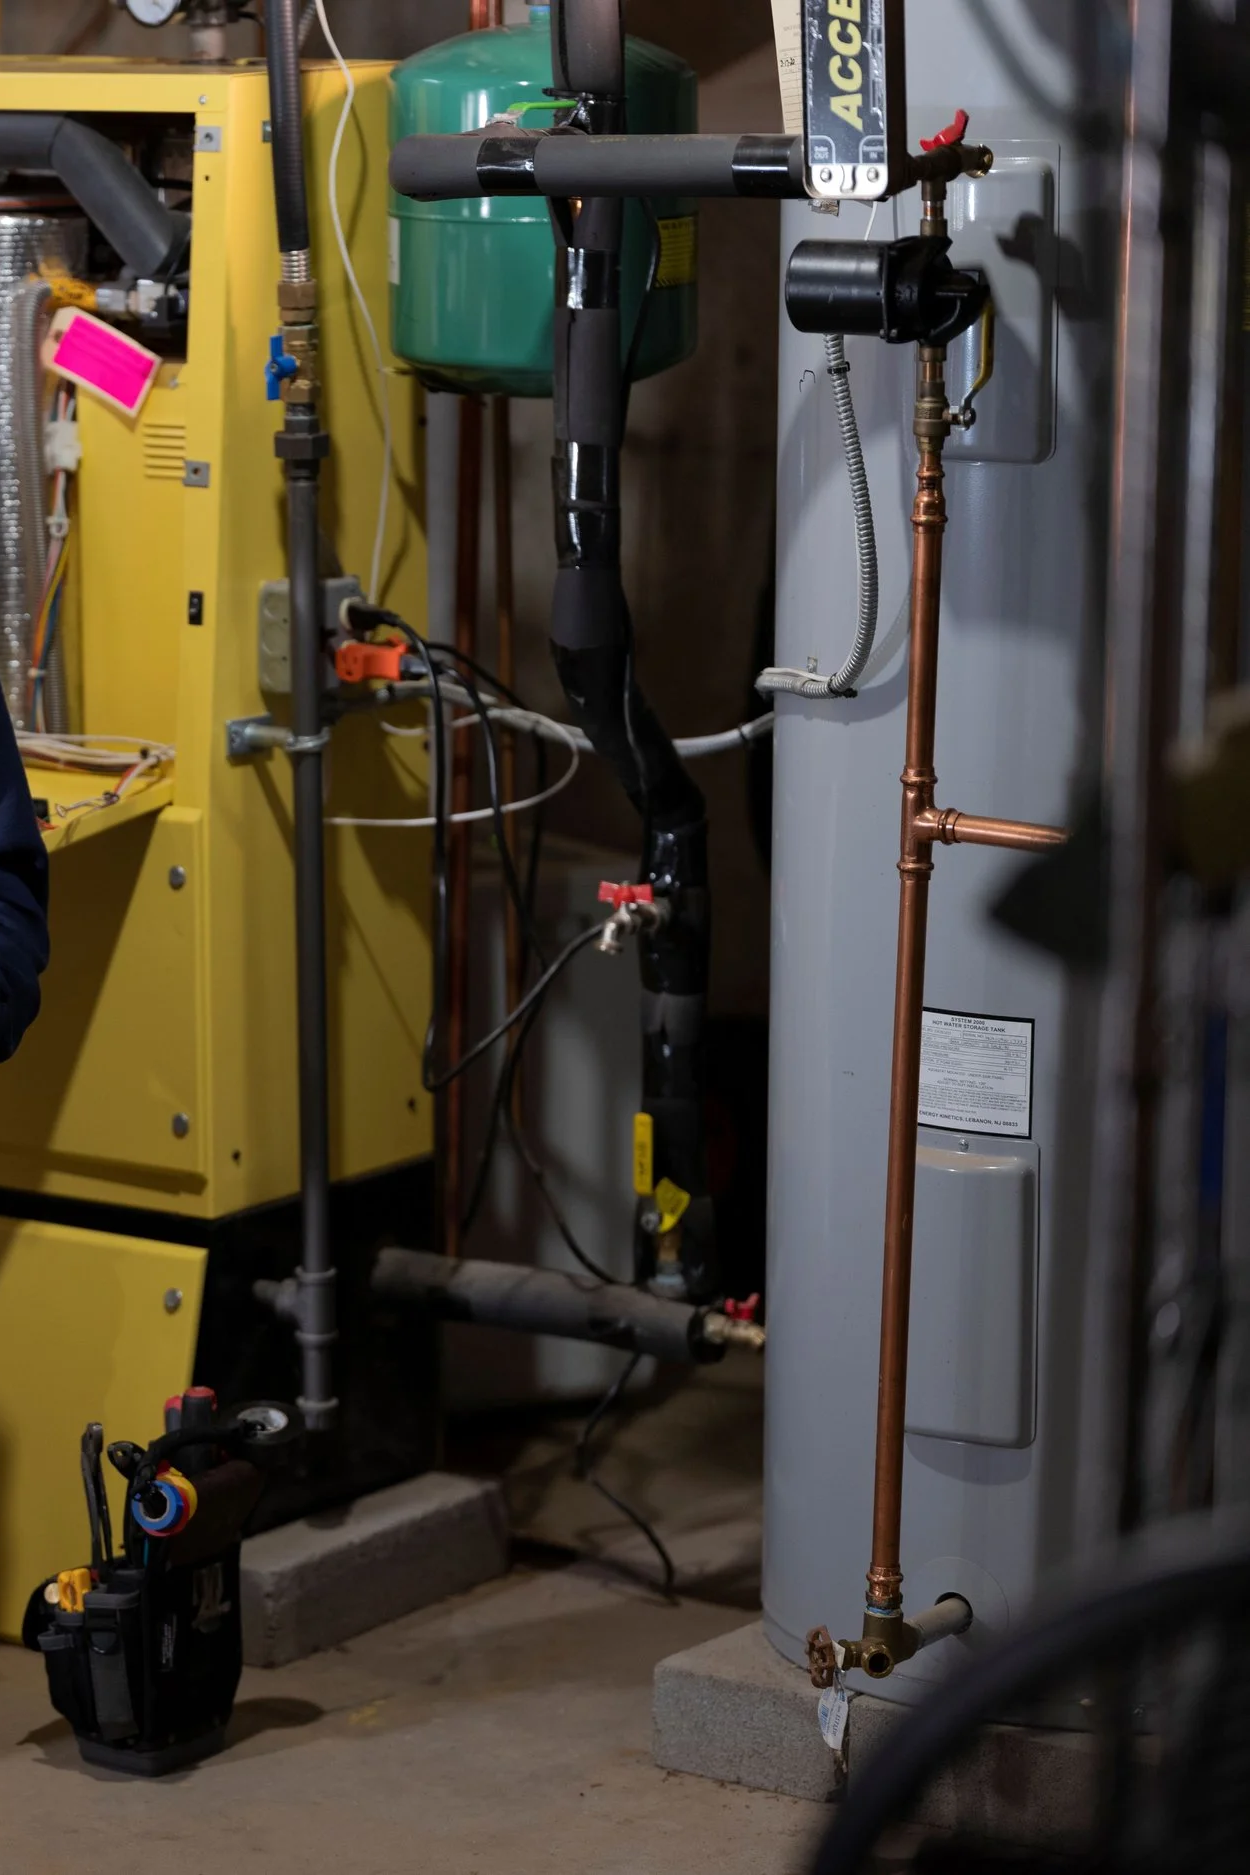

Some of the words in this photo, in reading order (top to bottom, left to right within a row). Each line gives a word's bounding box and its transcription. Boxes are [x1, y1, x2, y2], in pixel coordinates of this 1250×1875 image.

[963, 1023, 990, 1031] STORAGE
[919, 1110, 938, 1118] ENERGY
[940, 1113, 964, 1121] KINETICS,
[965, 1117, 993, 1125] LEBANON,
